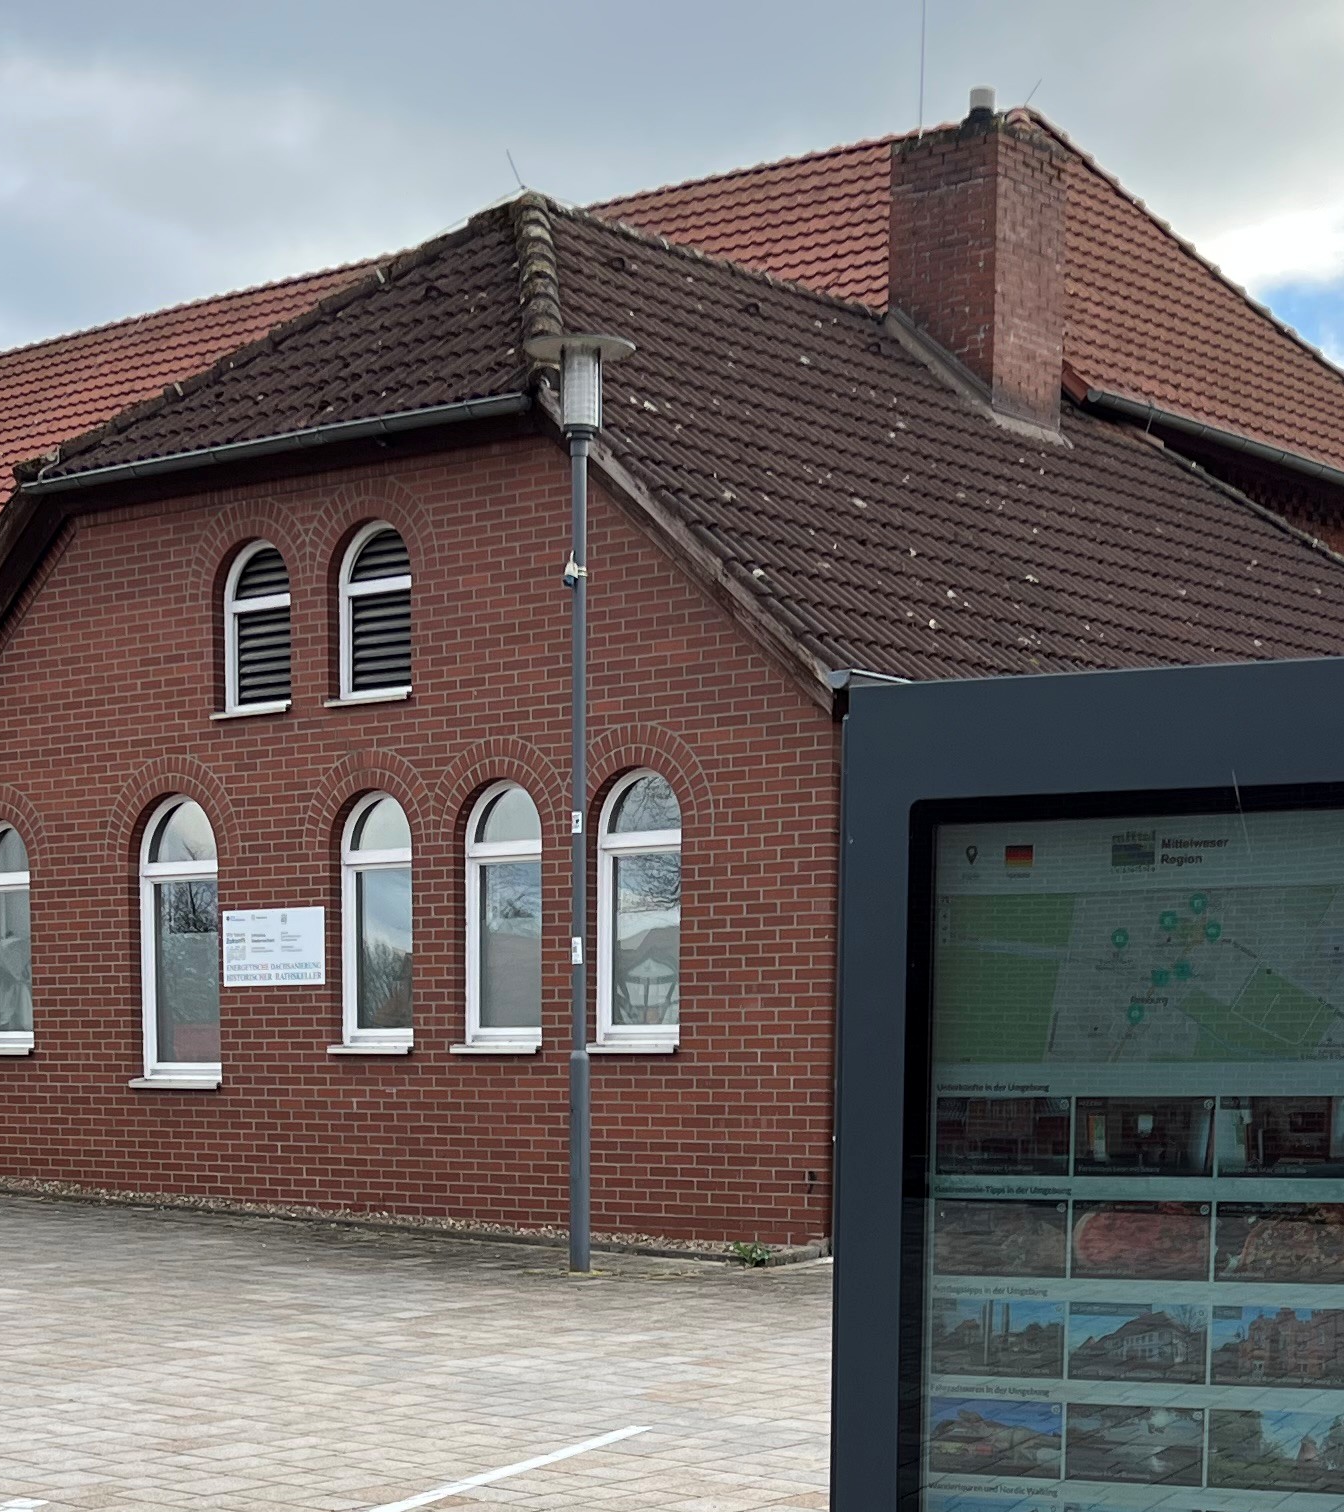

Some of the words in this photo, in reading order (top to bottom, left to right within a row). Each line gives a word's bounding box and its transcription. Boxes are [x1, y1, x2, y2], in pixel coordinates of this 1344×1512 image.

[1161, 854, 1202, 867] Region
[993, 1084, 1006, 1092] der
[1008, 1084, 1050, 1093] Umgebung
[1015, 1186, 1028, 1194] der
[1029, 1187, 1072, 1196] Umgebung
[1007, 1287, 1048, 1297] Umgebung
[994, 1385, 1007, 1393] der
[1008, 1387, 1049, 1397] Umgebung
[984, 1485, 998, 1493] und
[999, 1485, 1025, 1494] Nordic
[1026, 1487, 1058, 1498] Walking
